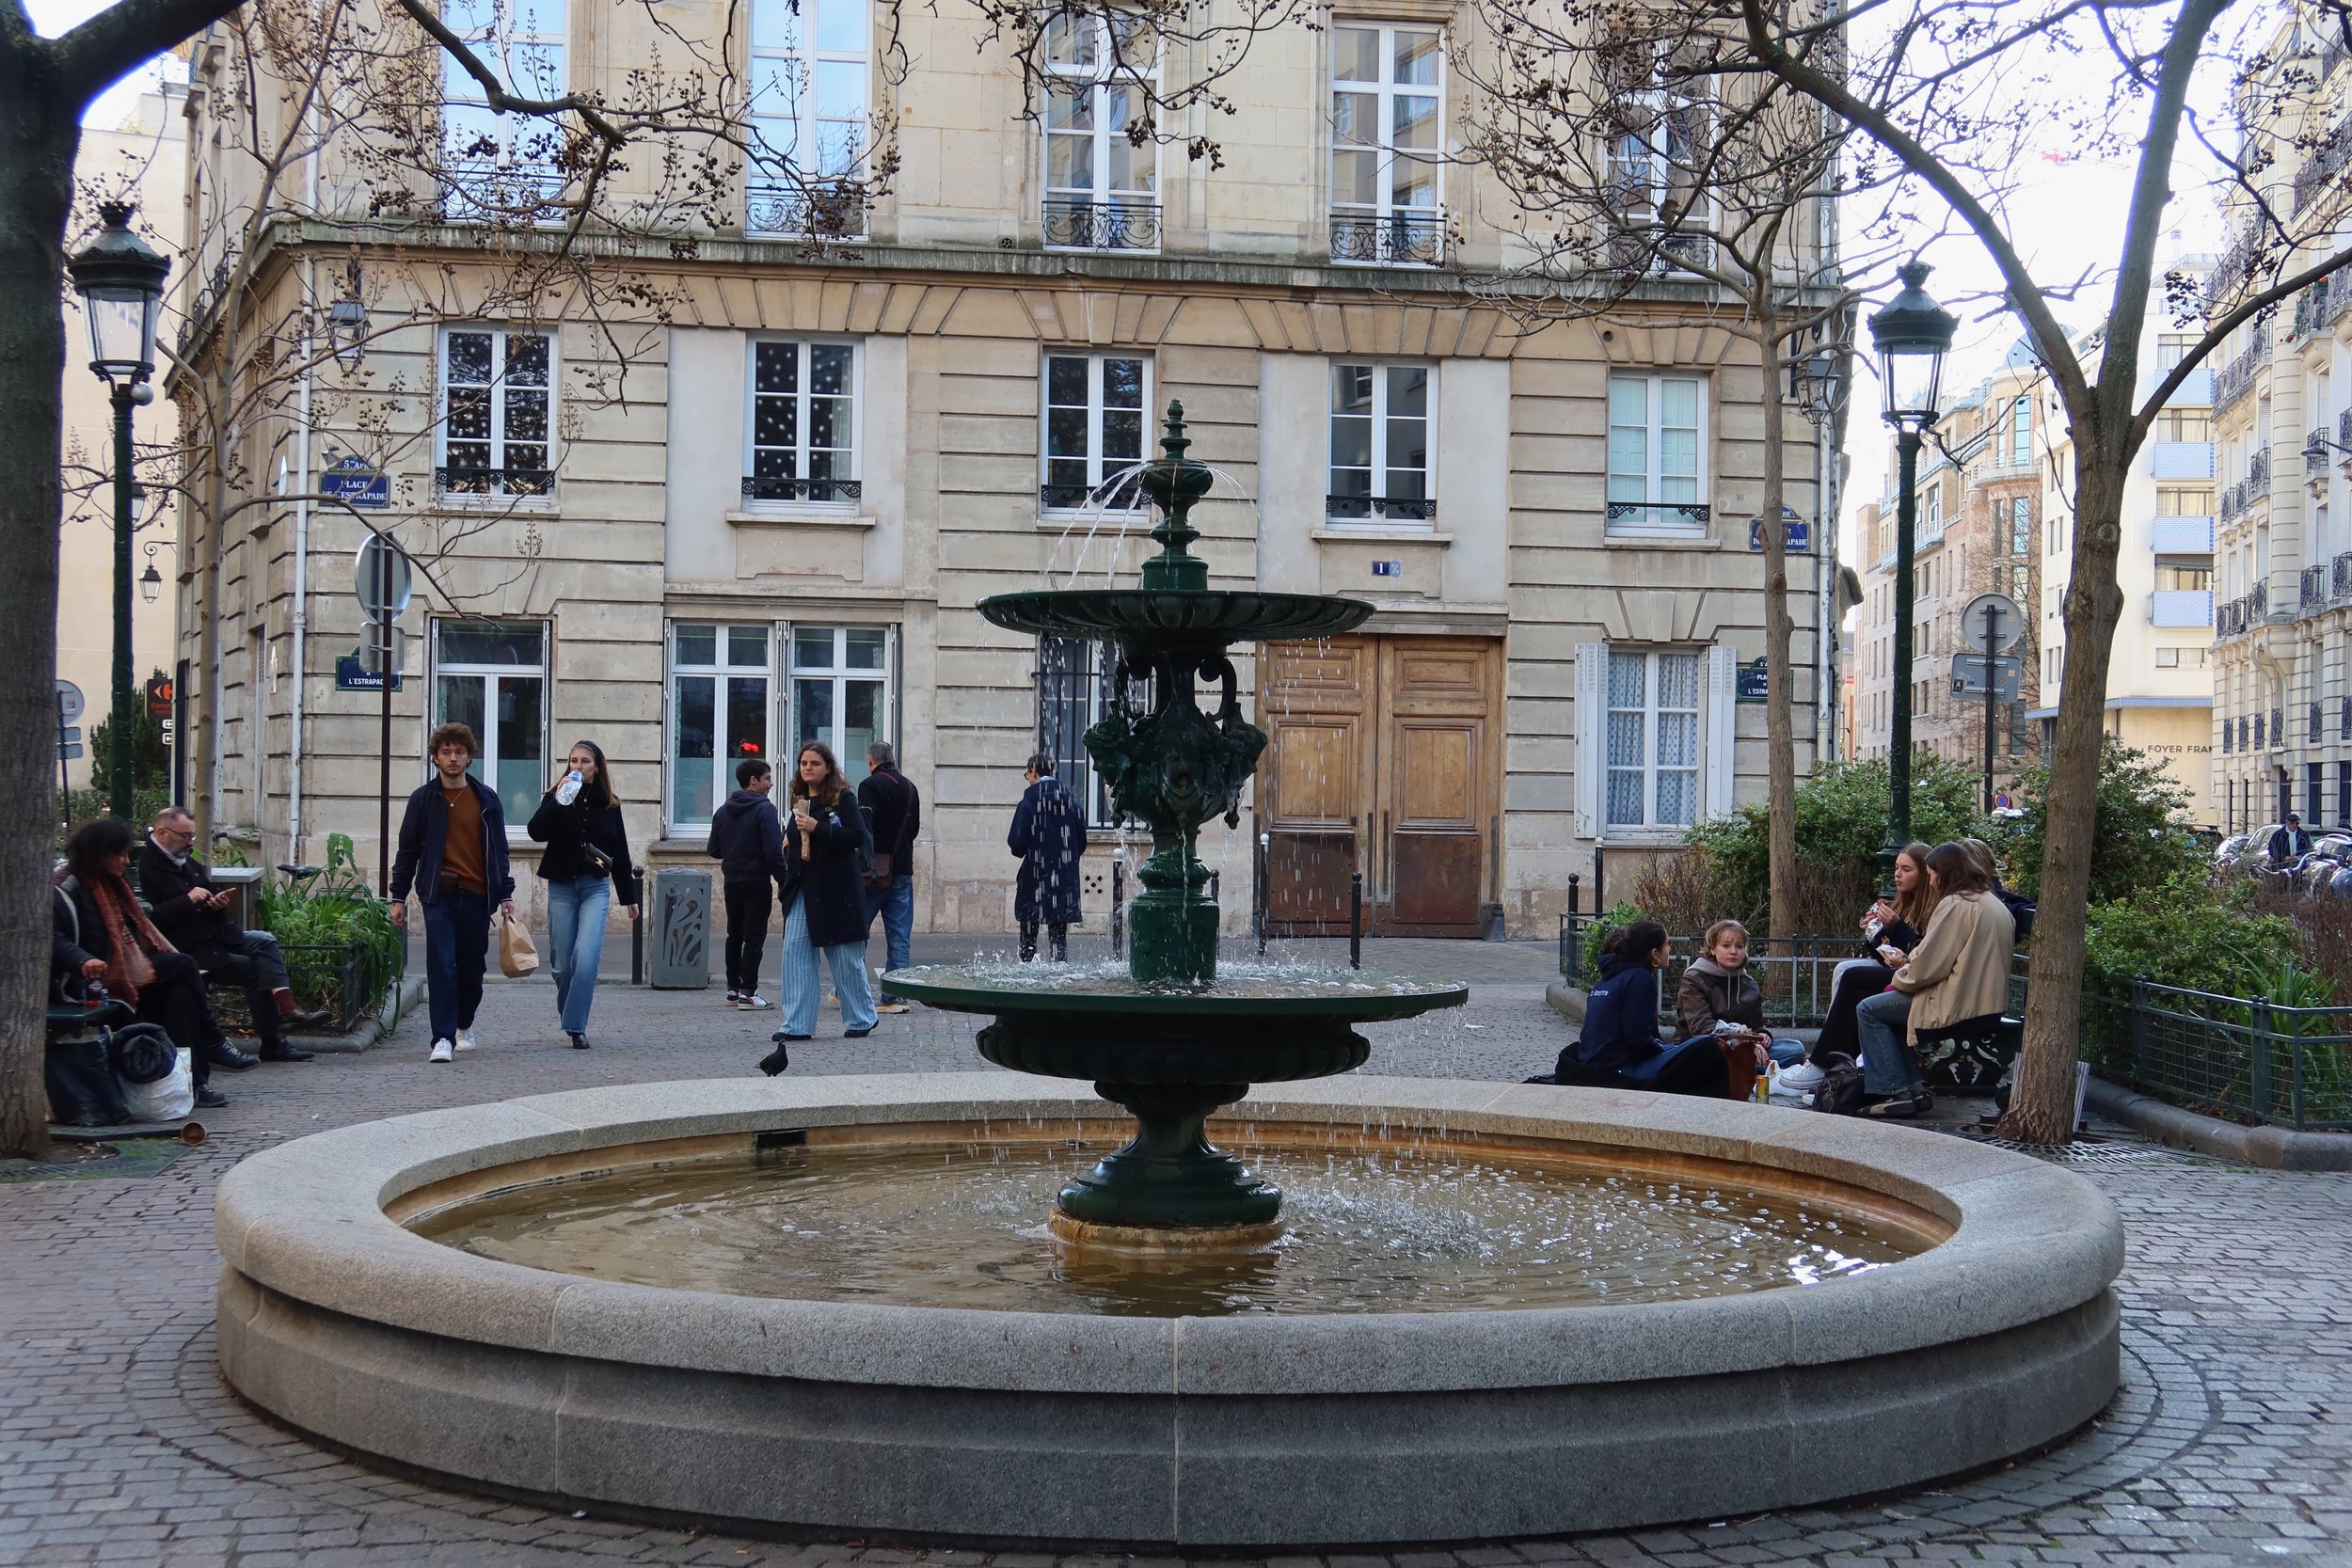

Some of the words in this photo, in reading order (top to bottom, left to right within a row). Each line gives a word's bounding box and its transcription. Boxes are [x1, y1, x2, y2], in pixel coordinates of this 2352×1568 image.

[1378, 562, 1384, 574] 1
[2148, 745, 2183, 753] FOYER
[2187, 745, 2212, 753] FRAN
